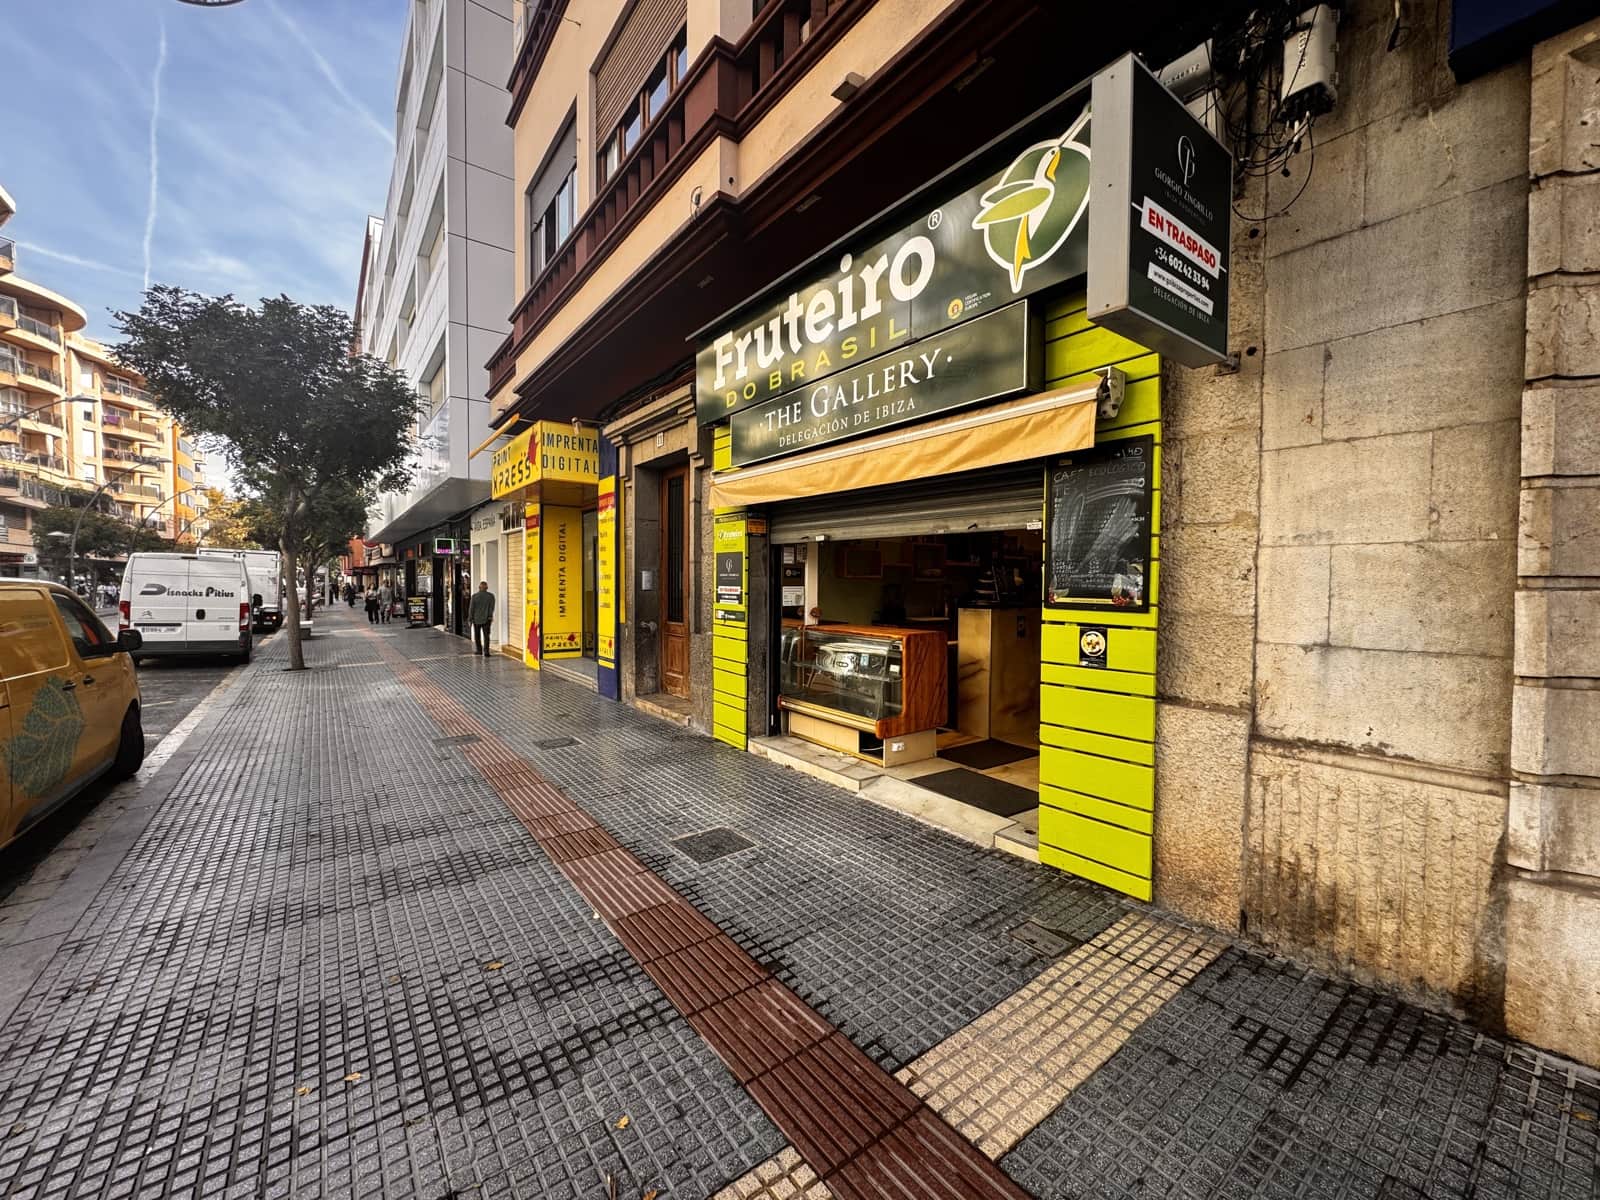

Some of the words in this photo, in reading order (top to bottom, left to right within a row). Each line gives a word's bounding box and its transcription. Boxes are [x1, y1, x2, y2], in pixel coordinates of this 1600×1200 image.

[1154, 167, 1183, 196] GIORGIO
[1183, 191, 1214, 222] ZINGRILLO
[1148, 207, 1164, 232] EN
[1166, 220, 1216, 269] TRASPASO
[1154, 247, 1168, 263] +34
[1168, 254, 1183, 273] 602
[1183, 264, 1192, 280] 42
[1192, 270, 1201, 285] 33
[1201, 276, 1210, 291] 94
[713, 235, 936, 391] Fruteiro
[1188, 305, 1196, 317] DE
[726, 382, 756, 408] DO
[769, 318, 907, 390] BRASIL
[542, 431, 598, 454] IMPRENTA
[779, 416, 848, 448] DELEGACIÓN
[854, 409, 870, 426] DE
[876, 397, 916, 420] IBIZA
[493, 446, 511, 466] PRINT
[542, 454, 598, 475] DIGITAL
[558, 522, 567, 563] DIGITAL
[139, 583, 203, 598] Disnacks
[205, 586, 235, 598] Pitius
[559, 567, 567, 618] IMPRENTA
